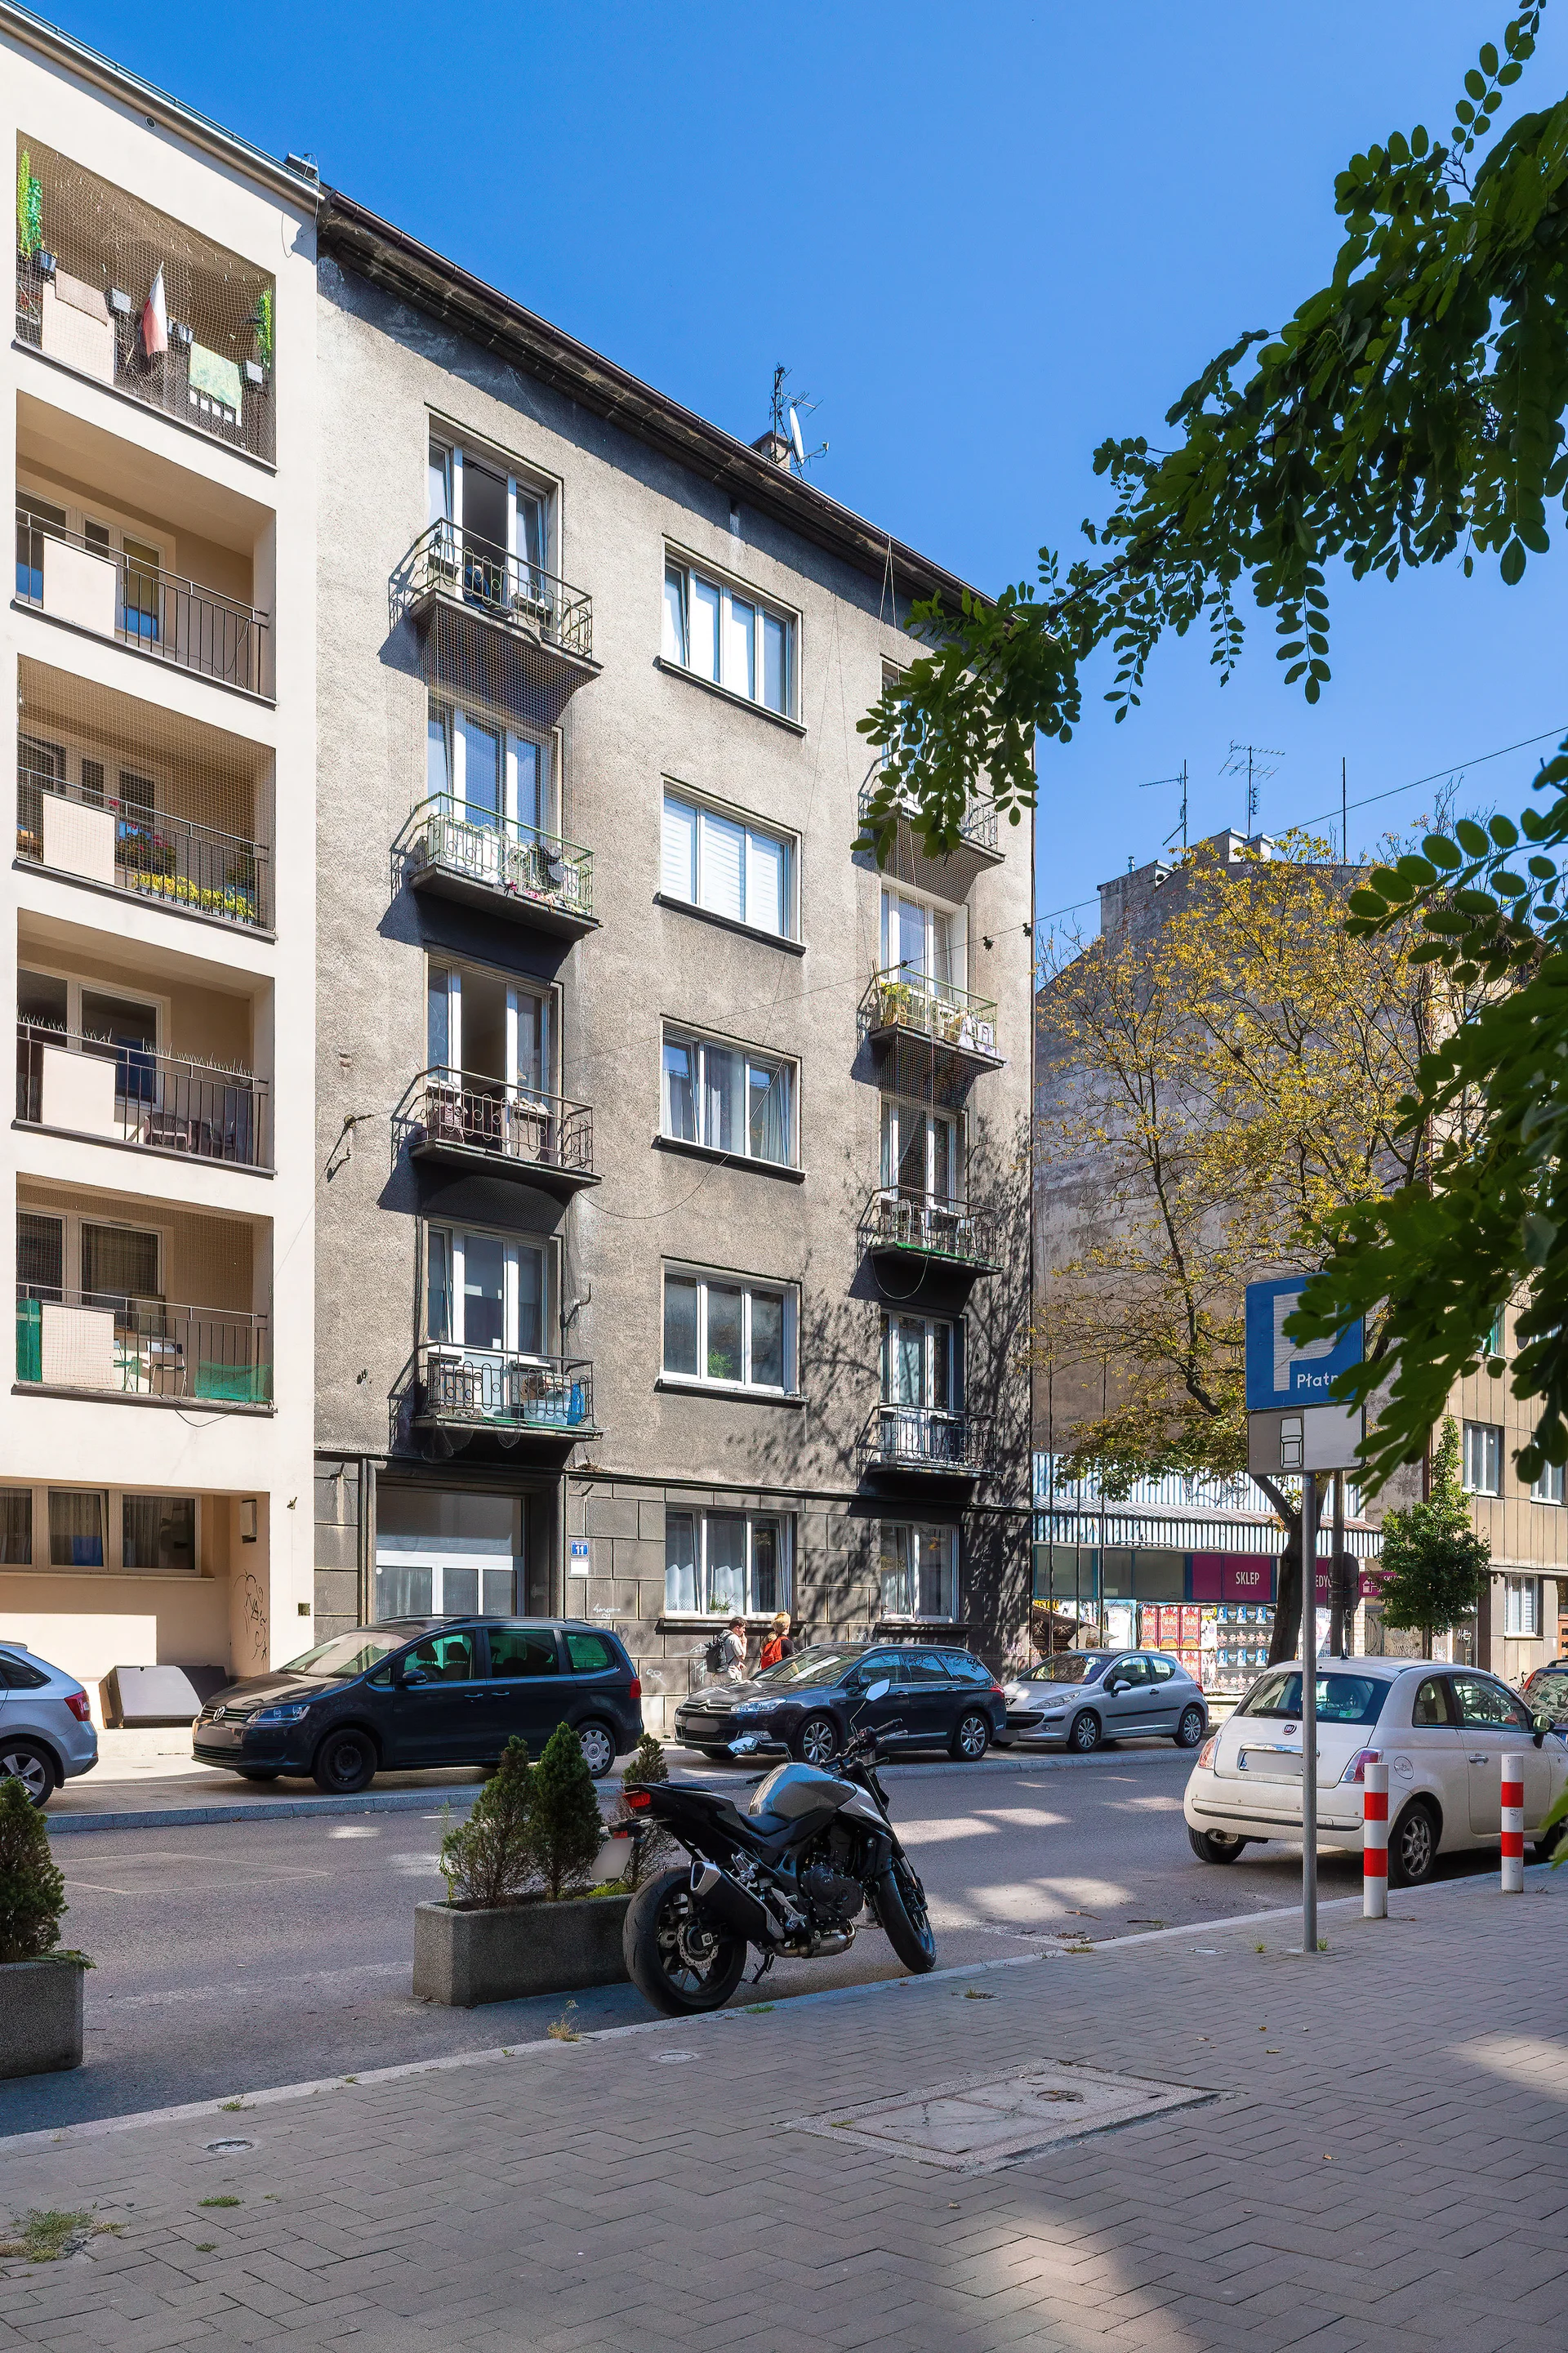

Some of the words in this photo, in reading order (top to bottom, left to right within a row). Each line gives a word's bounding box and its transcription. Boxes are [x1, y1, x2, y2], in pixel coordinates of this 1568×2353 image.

[1297, 1372, 1339, 1389] Płatn
[575, 1545, 584, 1554] 11
[1236, 1571, 1260, 1585] SKLEP
